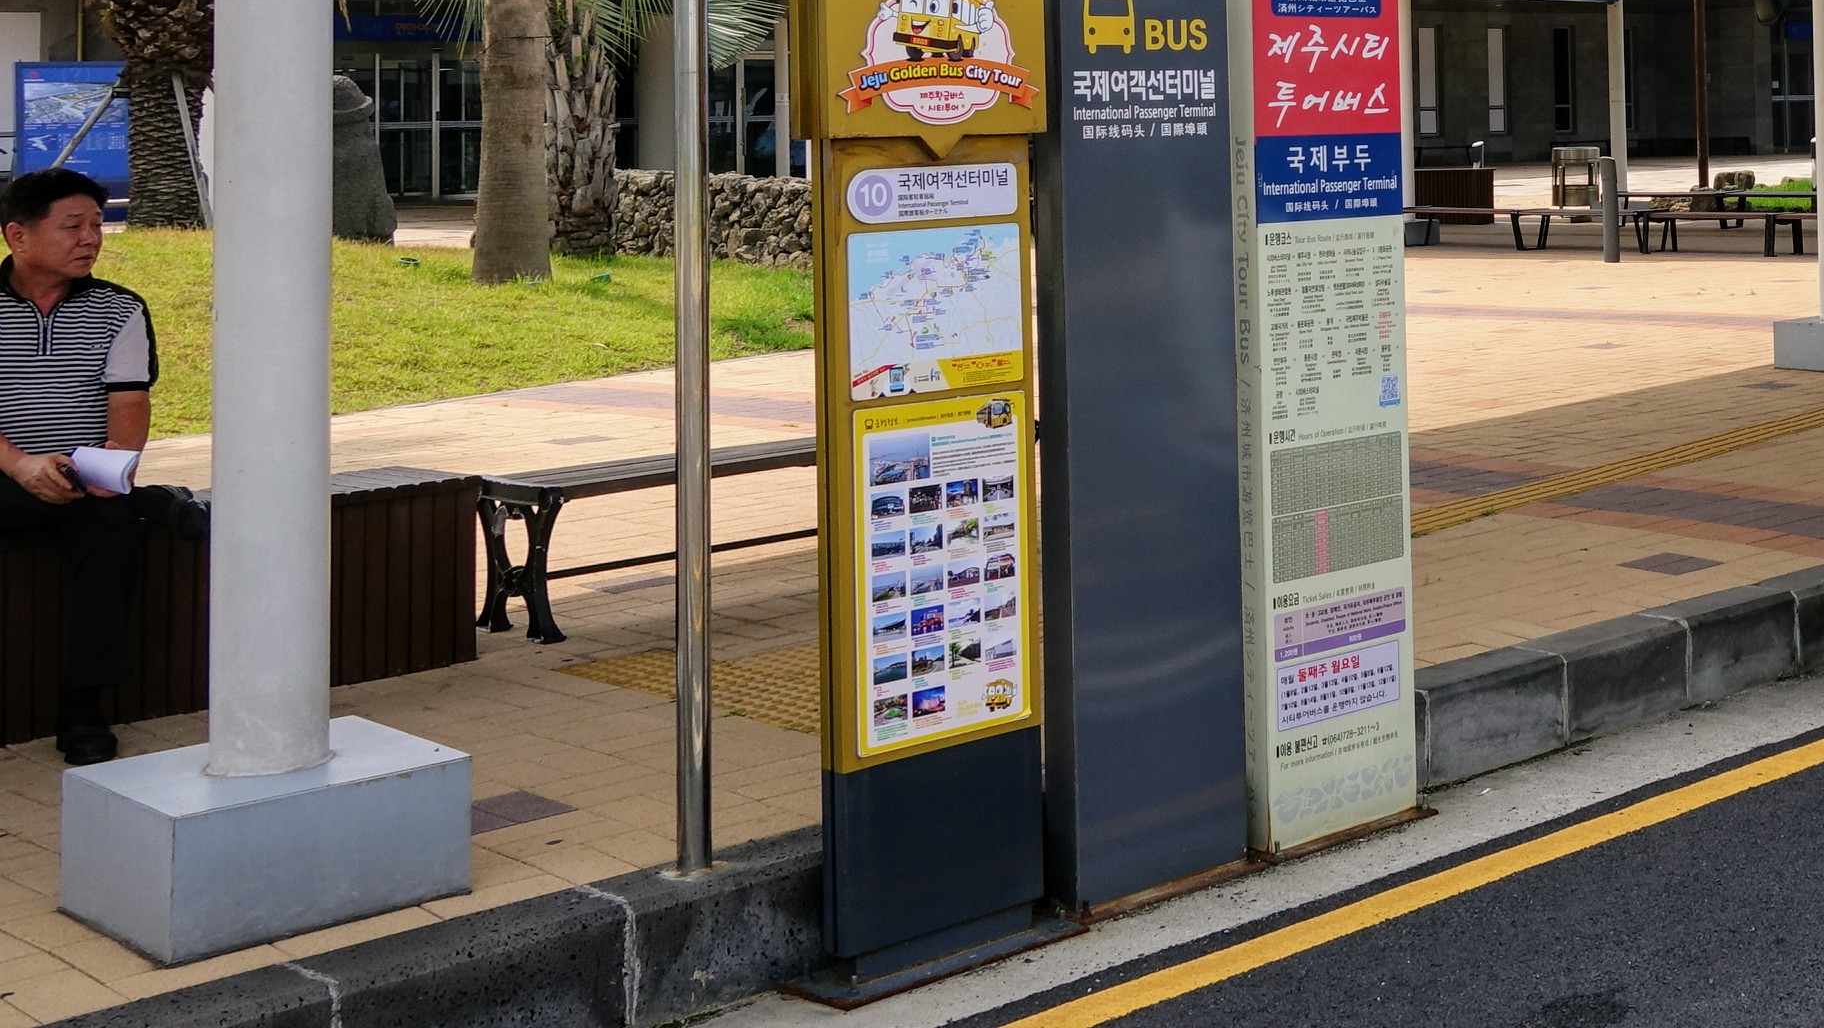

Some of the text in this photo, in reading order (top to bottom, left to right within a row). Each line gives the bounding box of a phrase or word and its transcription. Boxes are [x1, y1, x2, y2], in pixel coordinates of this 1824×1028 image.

[1144, 18, 1208, 51] BUS
[1267, 24, 1390, 73] 제주시티
[860, 64, 1022, 90] Jeju Golden Bus City Tour
[1073, 69, 1216, 102] 국제여객선터미널
[919, 90, 965, 102] 제주황금버스
[928, 103, 960, 112] 시티투어
[1267, 80, 1390, 128] 투어버스
[1073, 102, 1216, 121] International Passenger Terminal
[1082, 124, 1145, 139] 国际线码头
[1235, 136, 1249, 185] Jeju
[1286, 144, 1372, 173] 국제부두
[897, 168, 1009, 191] 국제여객선터미널
[1263, 174, 1398, 196] International Passenger Terminal
[860, 182, 888, 208] 10
[1237, 194, 1250, 244] City
[1269, 232, 1292, 247] 운행코스
[1307, 235, 1316, 243] Bus
[1317, 234, 1331, 242] Route
[1236, 254, 1249, 310] Tour
[1239, 318, 1251, 365] Bus
[1273, 429, 1296, 445] 운행시간
[1320, 428, 1344, 439] Operation
[1277, 592, 1300, 609] 이용요금
[1302, 594, 1318, 604] Ticket
[1319, 591, 1332, 601] Sales
[1297, 663, 1328, 683] 둘째주
[1331, 654, 1360, 674] 월요일
[1281, 704, 1330, 724] 시티투어버스를
[1331, 697, 1358, 713] 운행하지
[1280, 741, 1292, 757] 이용
[1295, 734, 1318, 754] 불편신고
[1280, 762, 1289, 772] For
